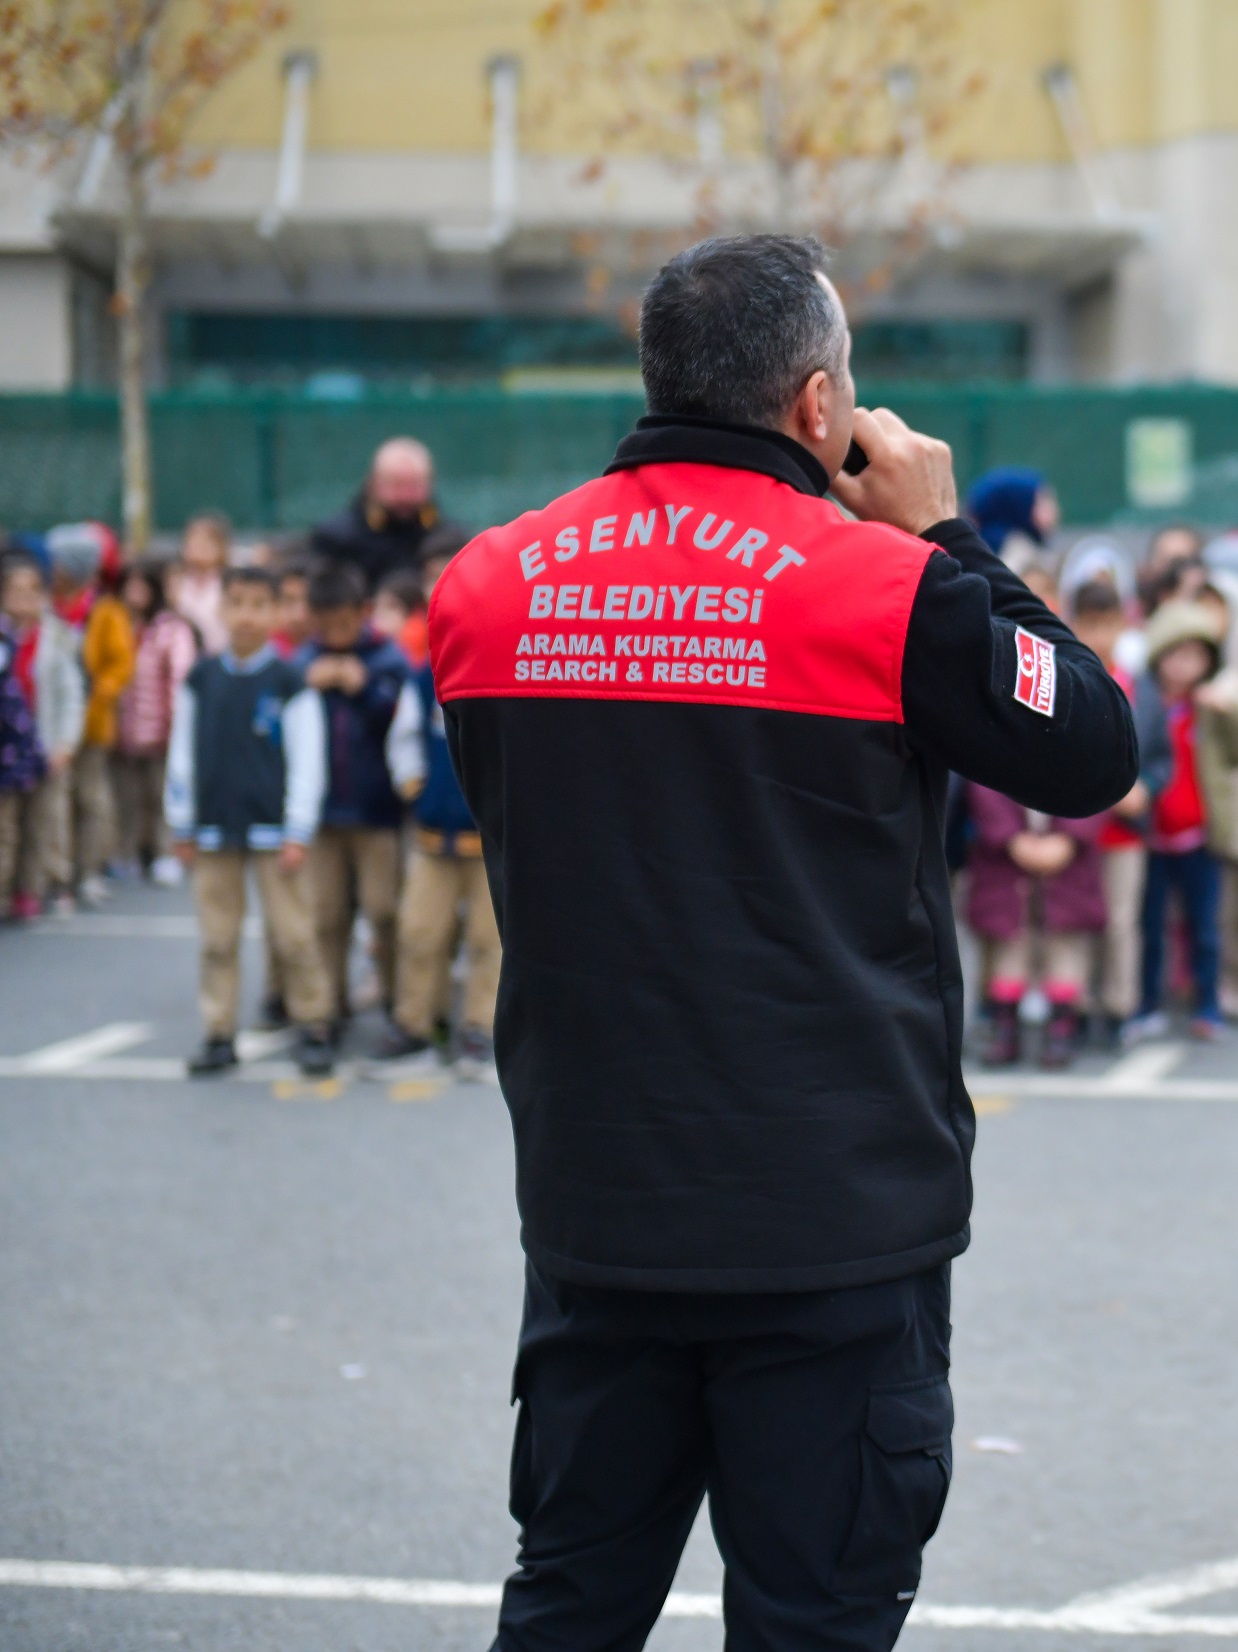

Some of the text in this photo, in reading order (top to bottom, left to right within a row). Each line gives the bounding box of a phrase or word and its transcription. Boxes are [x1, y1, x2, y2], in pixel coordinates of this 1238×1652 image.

[518, 504, 806, 581] ESENYURT
[515, 634, 766, 662] ARAMA KURTARMA
[514, 660, 766, 688] SEARCH & RESCUE
